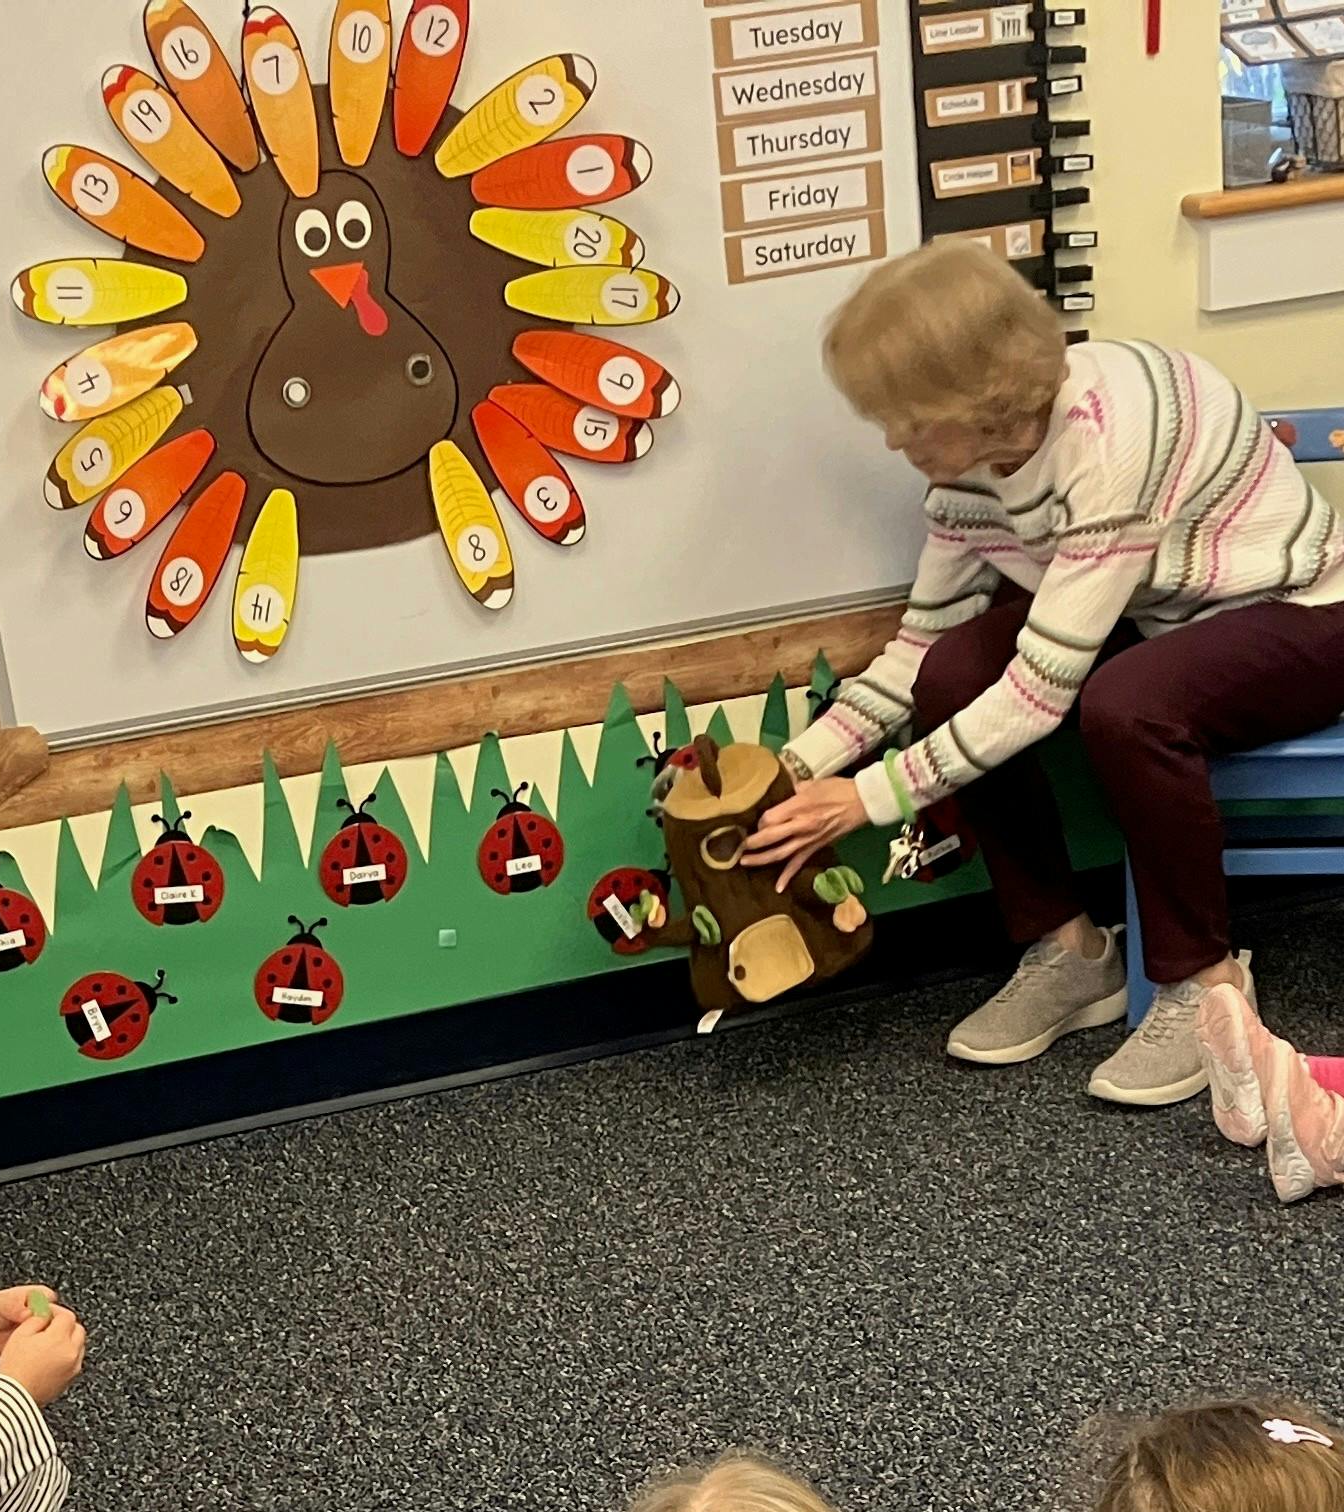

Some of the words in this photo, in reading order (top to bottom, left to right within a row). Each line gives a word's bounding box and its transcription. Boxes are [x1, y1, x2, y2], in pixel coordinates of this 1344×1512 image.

[352, 23, 371, 53] 10
[426, 16, 449, 47] 12
[749, 18, 843, 49] Tuesday
[171, 38, 198, 70] 16
[263, 55, 280, 84] 7
[732, 70, 865, 105] Wednesday
[529, 89, 555, 115] 2
[130, 100, 161, 133] 19
[747, 125, 852, 156] Thursday
[576, 166, 604, 174] 1
[80, 174, 108, 203] 13
[768, 183, 840, 211] Friday
[573, 227, 601, 258] 20
[755, 234, 857, 267] Saturday
[57, 287, 83, 299] 11
[611, 288, 638, 308] 17
[78, 373, 99, 393] 4
[606, 373, 634, 390] 9
[584, 418, 608, 440] 15
[81, 448, 103, 471] 5
[113, 499, 133, 525] 6
[537, 487, 557, 511] 3
[468, 534, 486, 561] 8
[169, 567, 194, 598] 18
[252, 594, 271, 622] 14
[515, 861, 533, 872] Leo
[160, 890, 187, 901] Claire
[87, 1007, 103, 1033] Bryn
